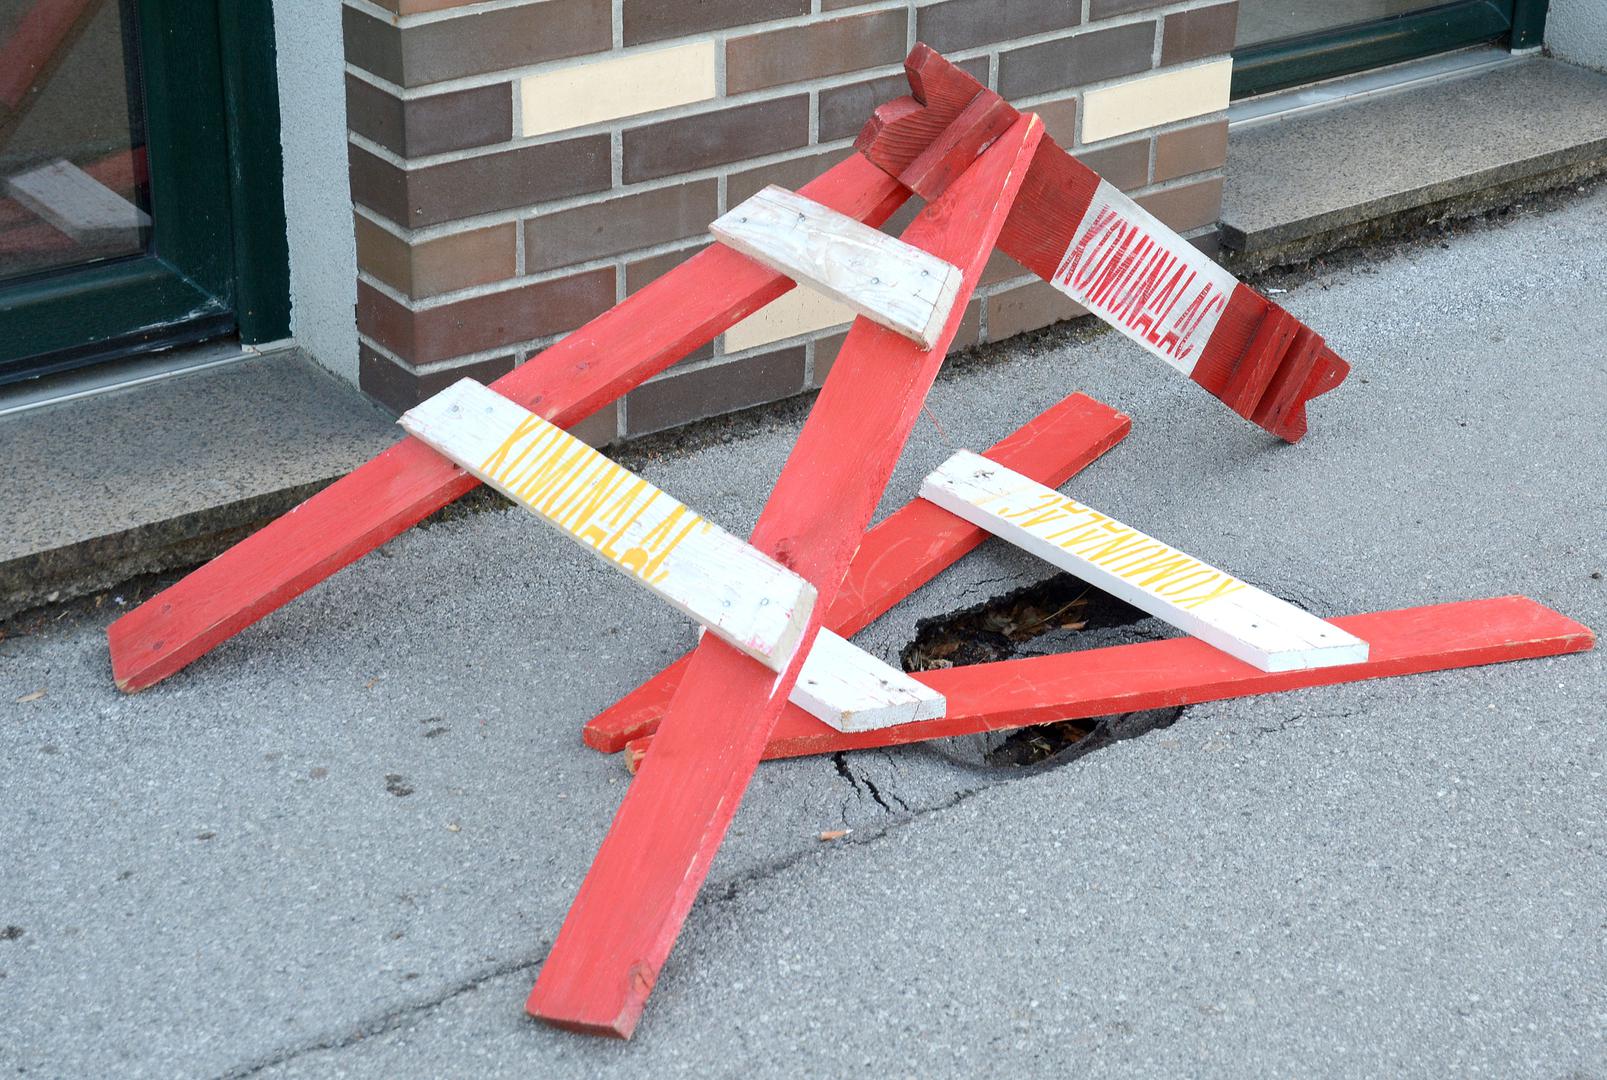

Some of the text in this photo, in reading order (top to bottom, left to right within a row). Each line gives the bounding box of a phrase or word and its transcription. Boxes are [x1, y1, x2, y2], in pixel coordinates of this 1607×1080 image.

[1055, 204, 1228, 361] KOMUNALAC
[479, 414, 713, 585] KOMUNALAC
[997, 493, 1246, 609] KOMUNALAC
